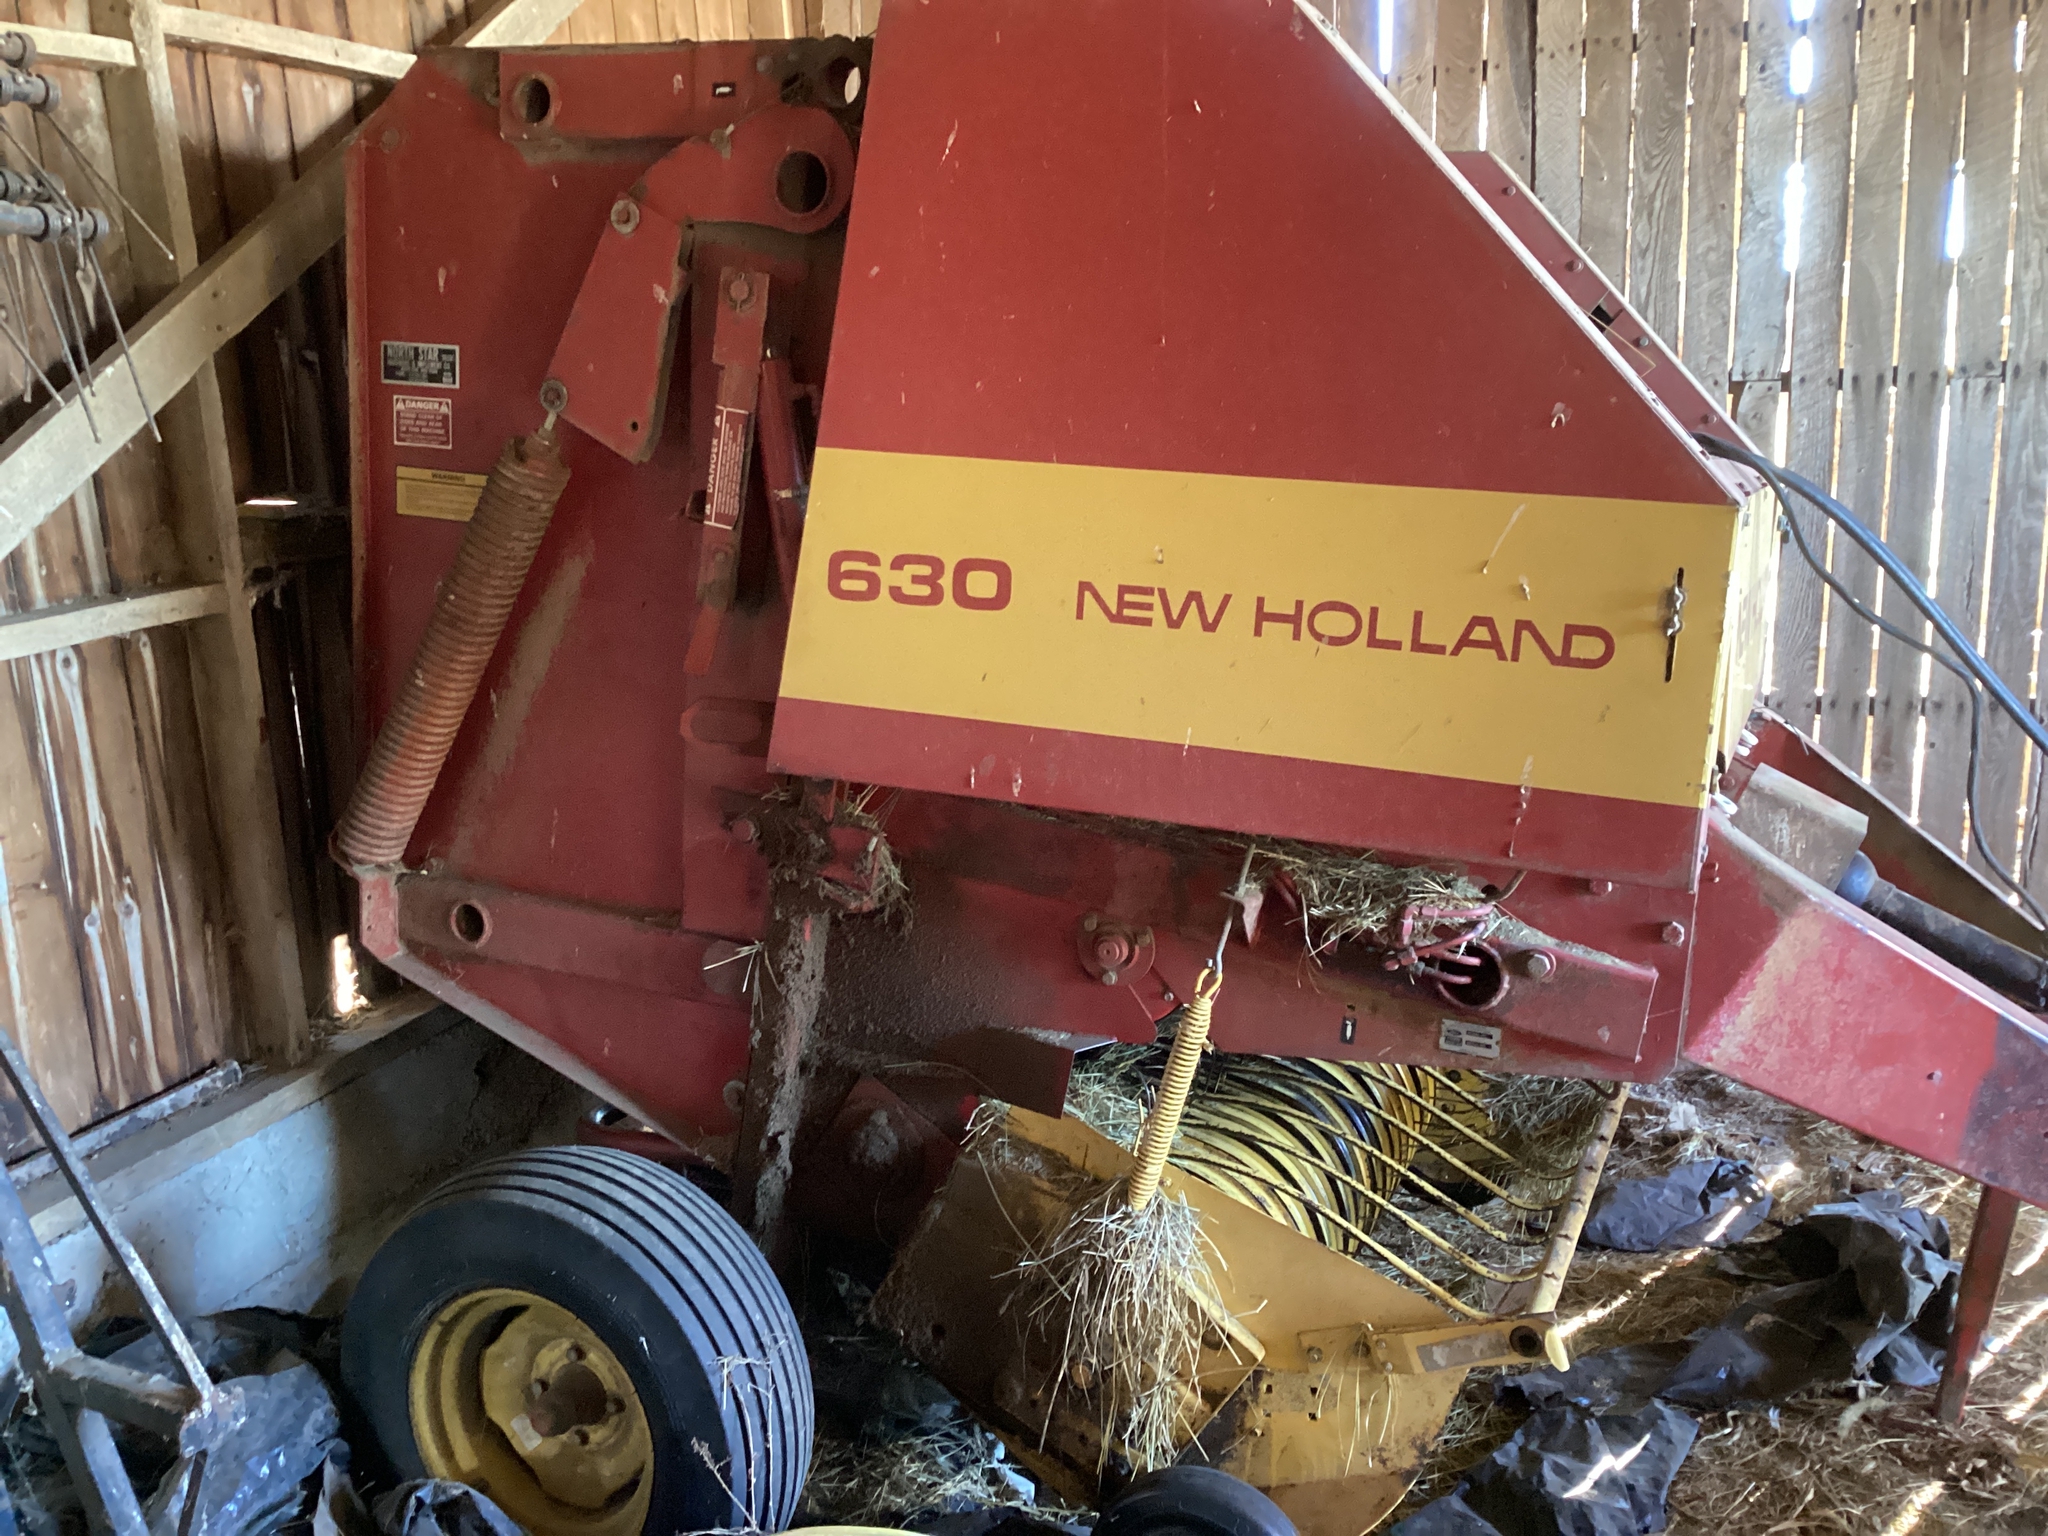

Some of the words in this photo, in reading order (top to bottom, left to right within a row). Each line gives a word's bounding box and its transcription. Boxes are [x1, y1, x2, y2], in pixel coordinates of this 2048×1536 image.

[418, 346, 439, 361] STAR
[405, 400, 440, 410] DANGER
[706, 437, 719, 493] DANGER
[827, 550, 1012, 611] 630
[1076, 580, 1233, 633] NEW
[1253, 595, 1616, 670] HOLLAND
